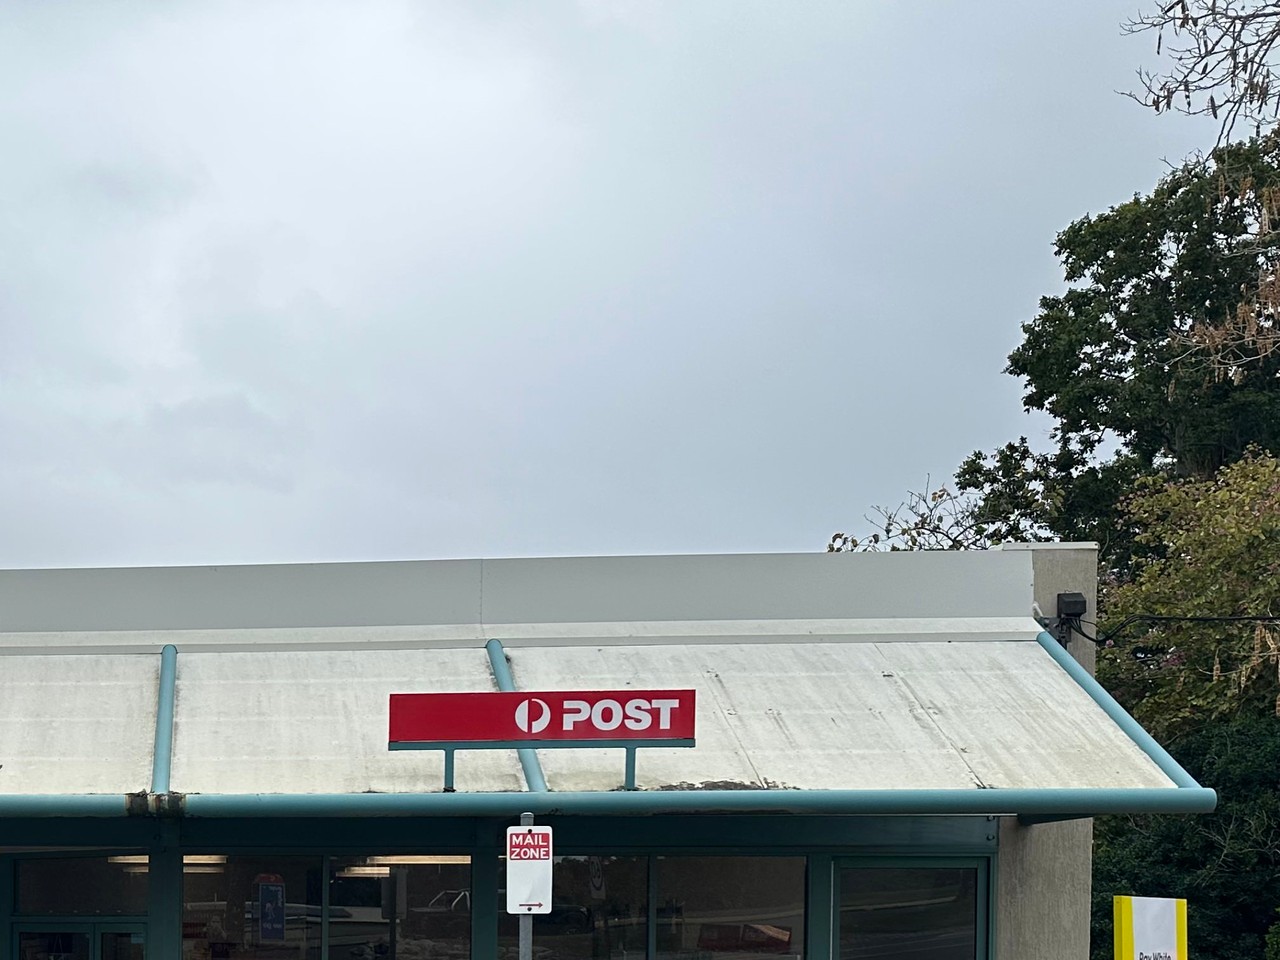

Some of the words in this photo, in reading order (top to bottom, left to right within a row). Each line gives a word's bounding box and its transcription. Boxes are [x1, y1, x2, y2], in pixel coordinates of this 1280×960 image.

[562, 699, 680, 731] POST
[512, 834, 548, 846] MAIL
[510, 847, 550, 859] ZONE
